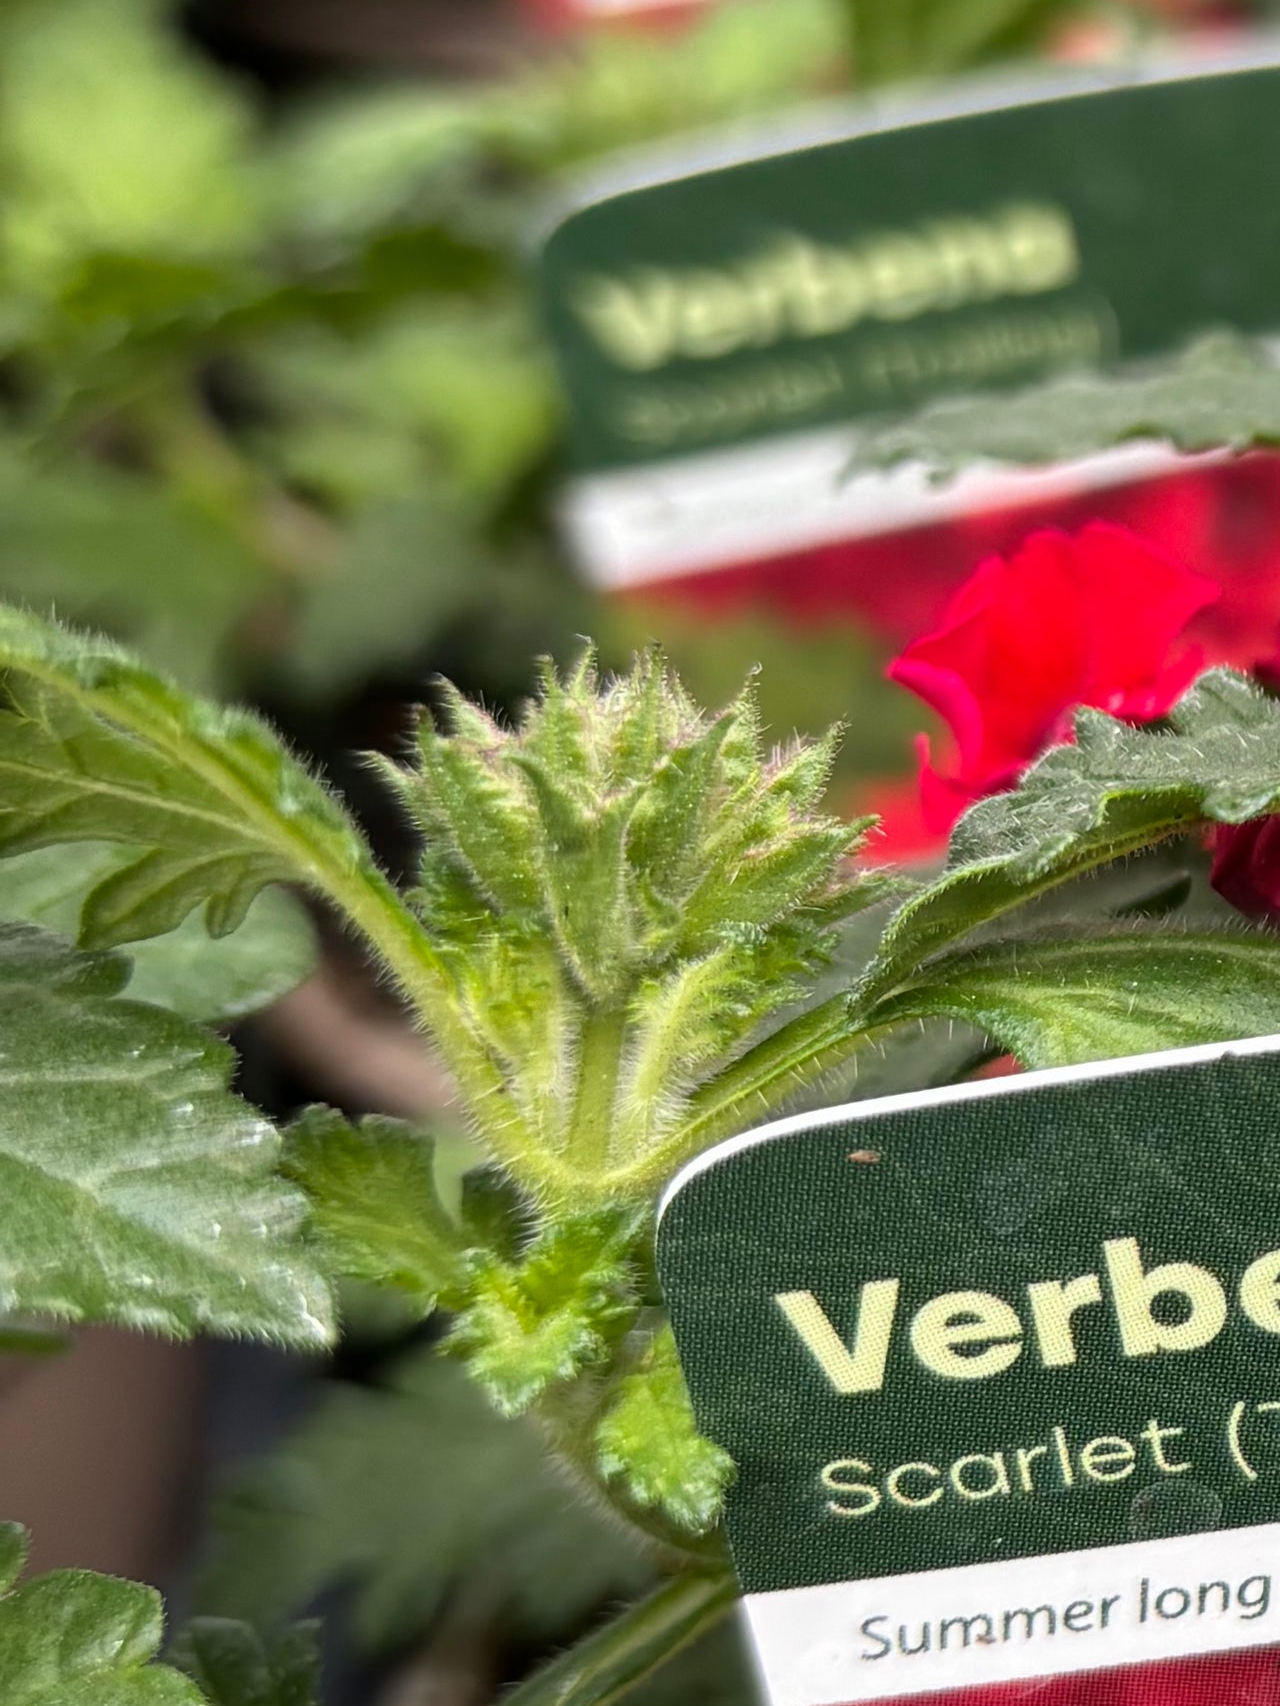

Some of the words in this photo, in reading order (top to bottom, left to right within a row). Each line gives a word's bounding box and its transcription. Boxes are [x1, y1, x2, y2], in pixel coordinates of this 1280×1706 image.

[819, 1419, 1191, 1517] Scarlet
[859, 1589, 1121, 1661] Summer
[1138, 1570, 1271, 1626] long
